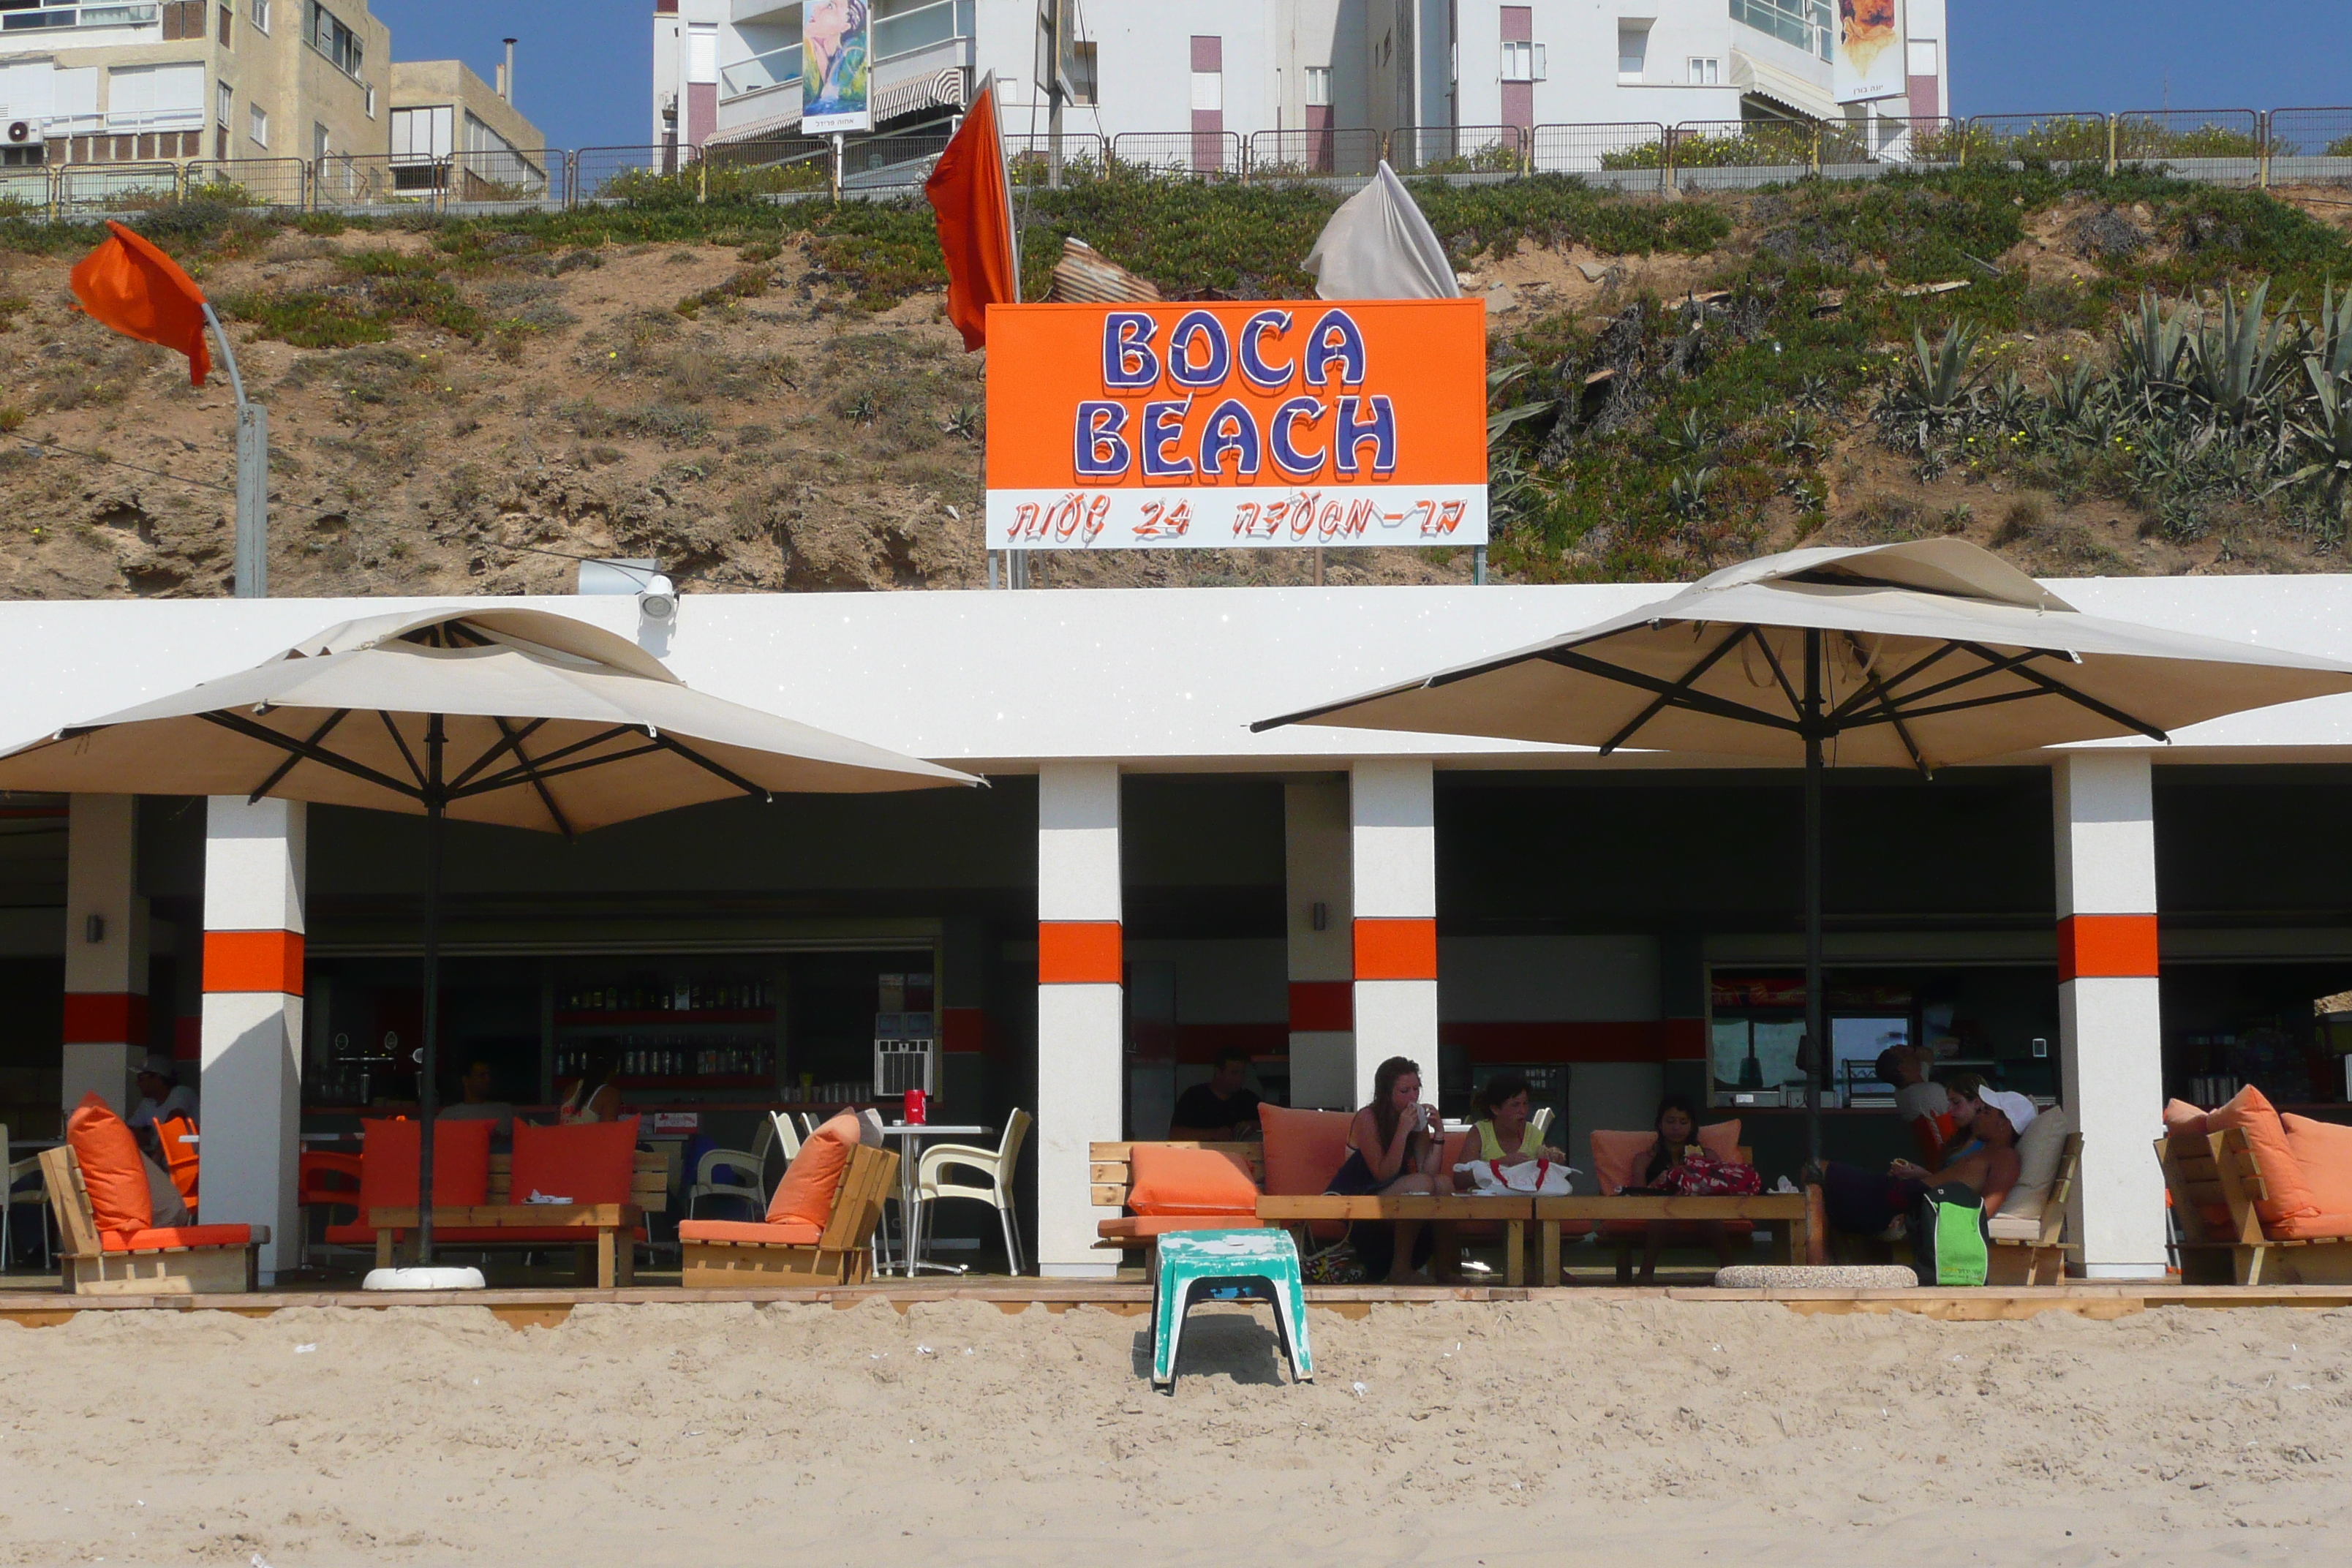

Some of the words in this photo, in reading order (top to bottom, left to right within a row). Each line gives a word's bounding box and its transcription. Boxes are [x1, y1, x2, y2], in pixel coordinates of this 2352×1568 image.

[1102, 309, 1367, 388] BOCA
[1073, 392, 1398, 476] BEACH
[1006, 491, 1112, 538] שעות
[1131, 497, 1195, 535] 24
